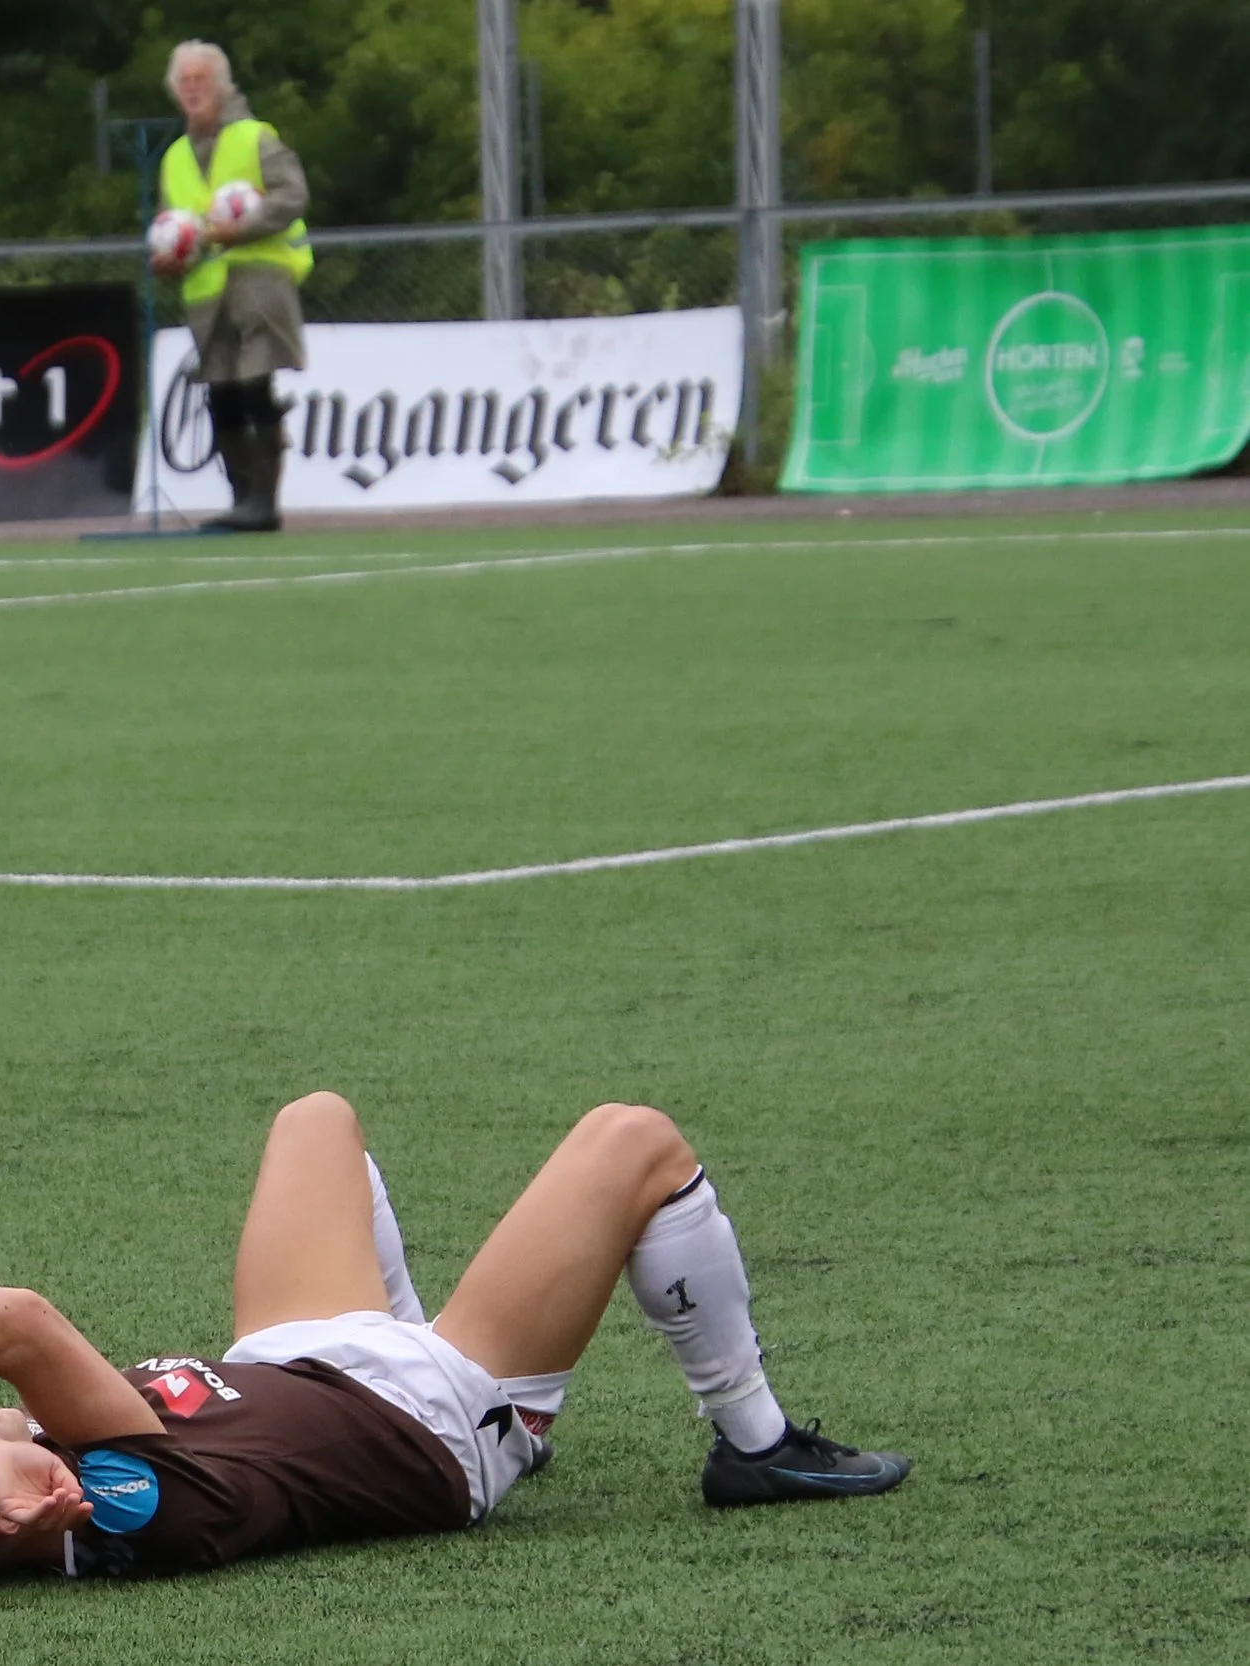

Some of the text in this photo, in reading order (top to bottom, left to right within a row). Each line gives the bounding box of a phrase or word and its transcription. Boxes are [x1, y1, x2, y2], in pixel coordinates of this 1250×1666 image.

[995, 344, 1098, 372] HORTEN
[44, 366, 66, 429] 1
[161, 349, 715, 489] Gngangeren
